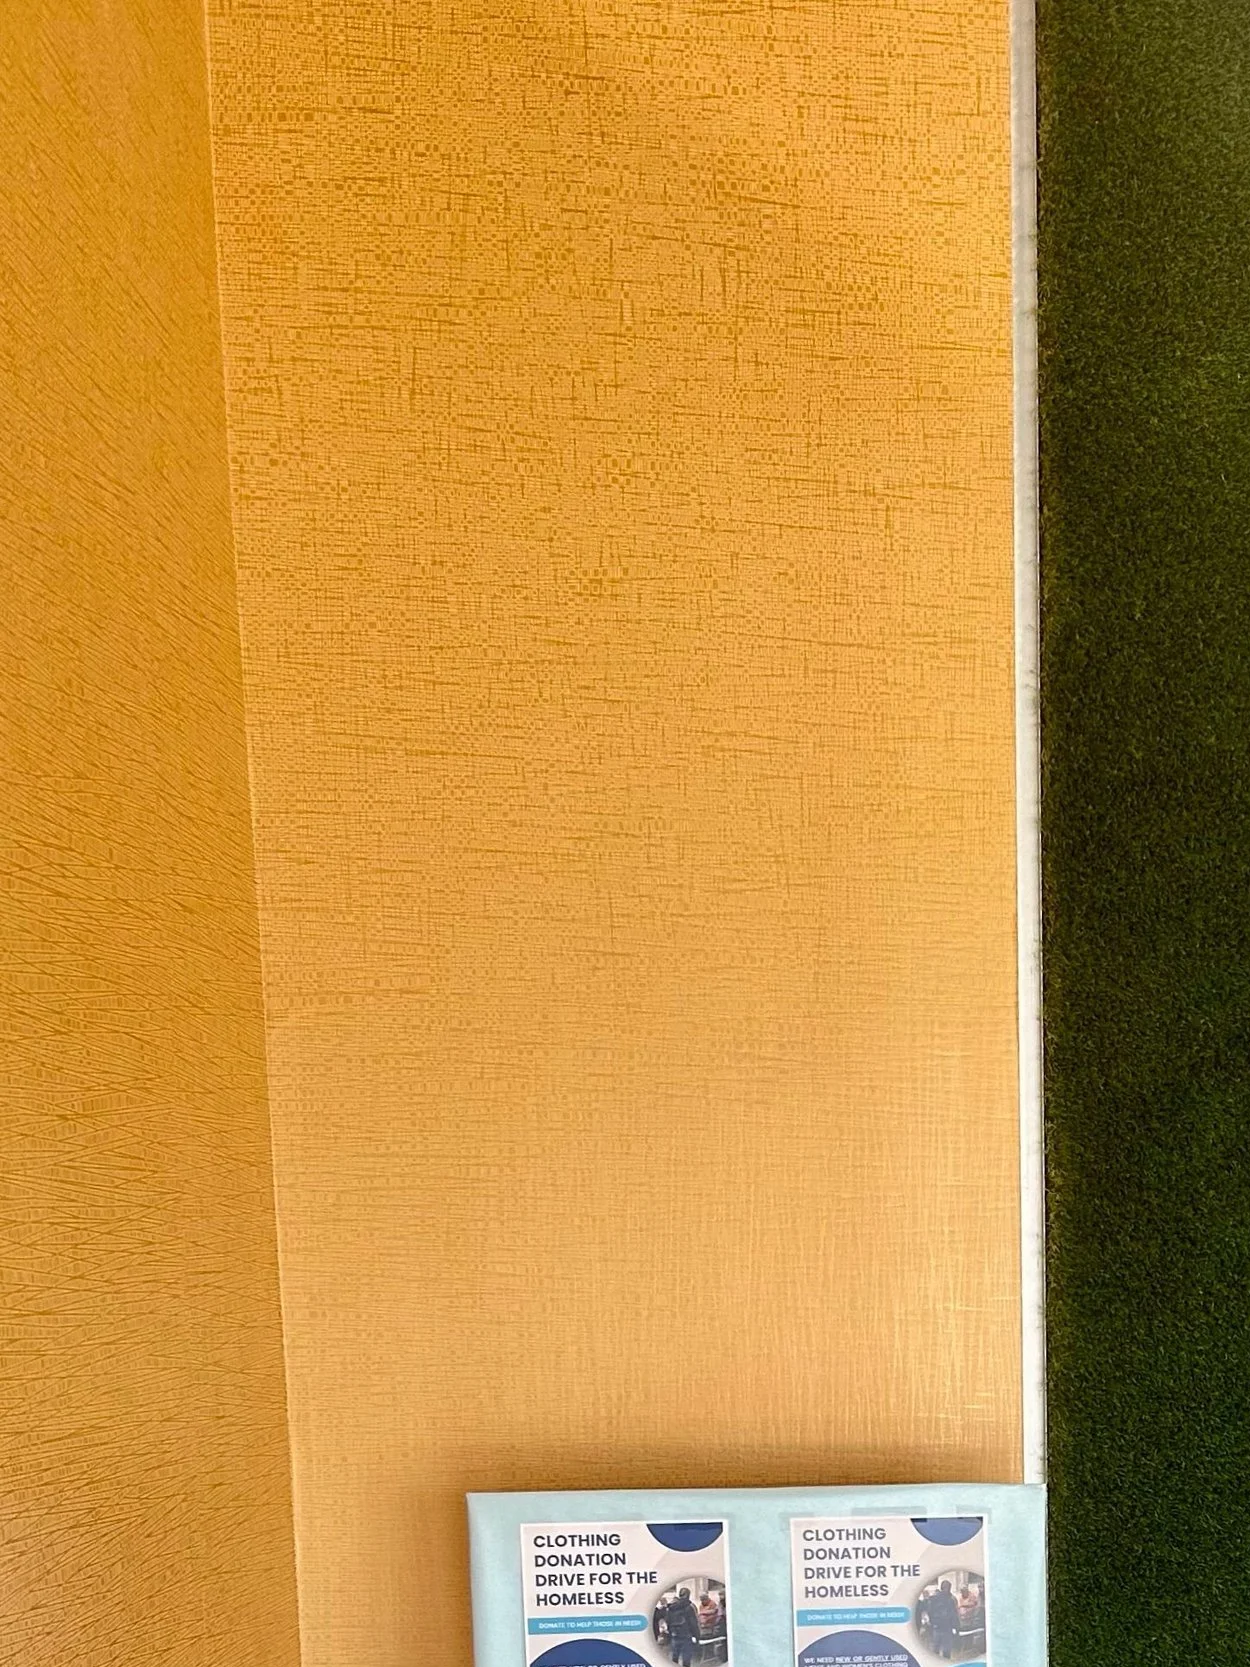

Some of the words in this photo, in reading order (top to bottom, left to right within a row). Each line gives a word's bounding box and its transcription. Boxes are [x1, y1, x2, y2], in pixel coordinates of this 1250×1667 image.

[533, 1534, 621, 1547] CLOTHING
[802, 1527, 886, 1541] CLOTHING
[534, 1552, 626, 1567] DONATION
[803, 1546, 891, 1560] DONATION
[804, 1566, 851, 1579] DRIVE
[856, 1565, 887, 1578] FOR
[890, 1564, 921, 1577] THE
[535, 1573, 585, 1587] DRIVE
[589, 1572, 622, 1585] FOR
[626, 1571, 658, 1584] THE
[805, 1584, 889, 1598] HOMELESS
[536, 1591, 624, 1606] HOMELESS
